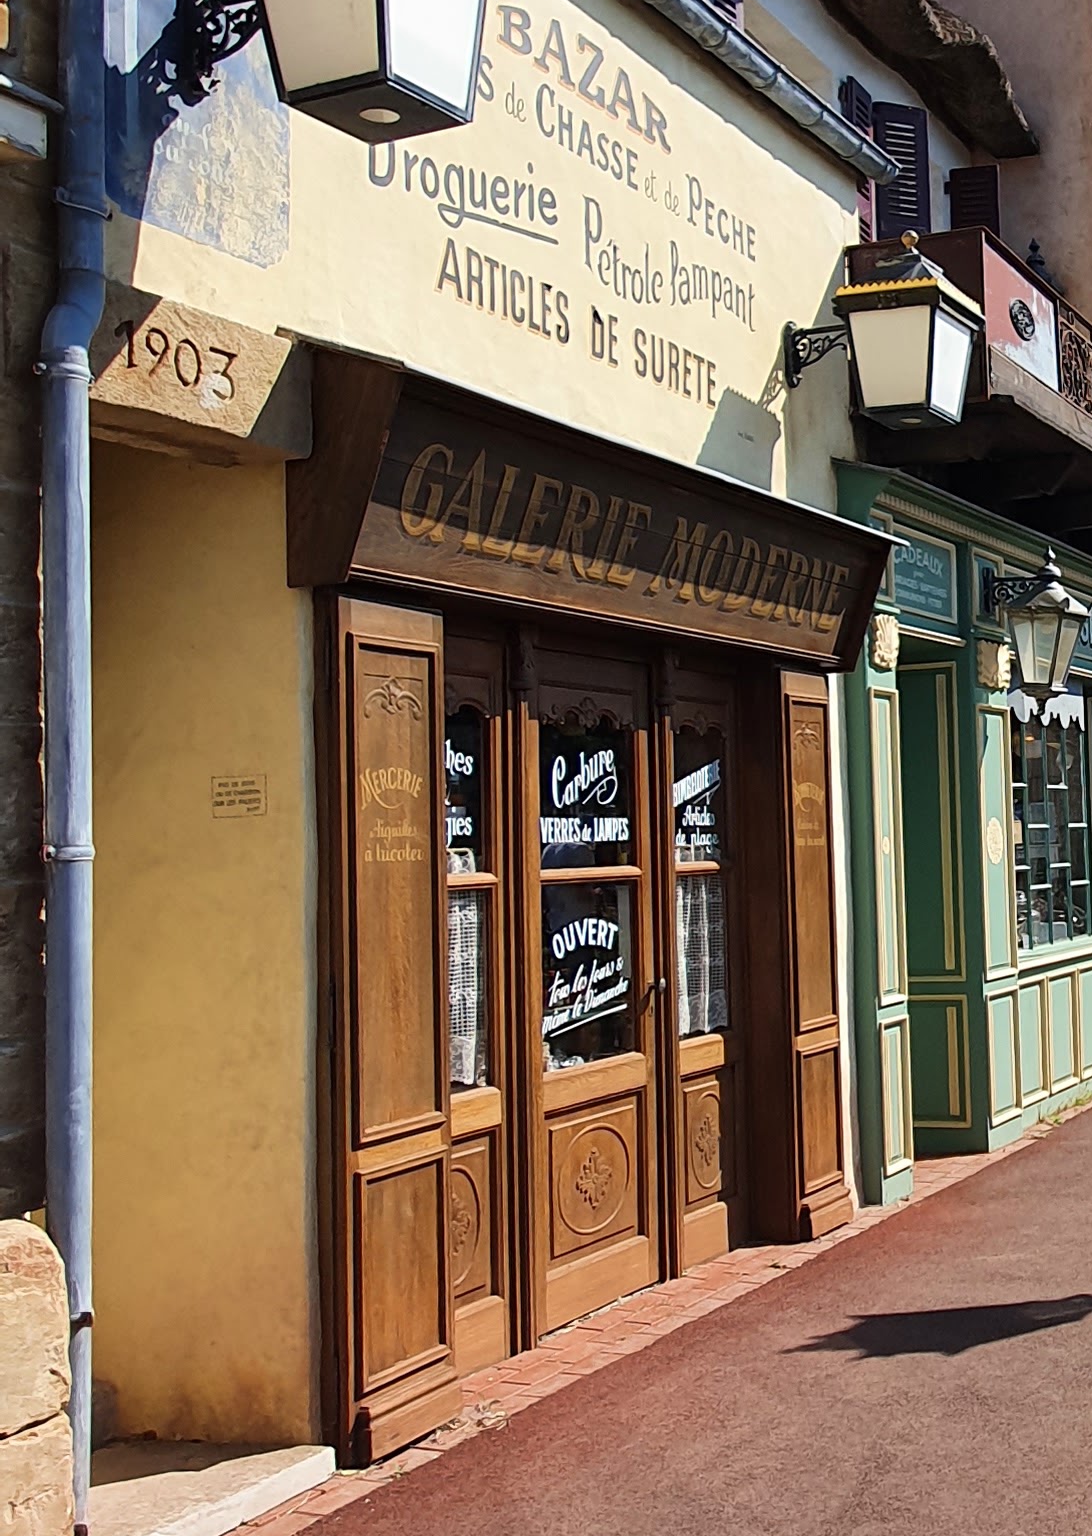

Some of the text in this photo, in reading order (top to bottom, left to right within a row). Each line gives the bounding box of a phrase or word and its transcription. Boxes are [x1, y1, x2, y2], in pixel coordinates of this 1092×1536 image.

[497, 5, 672, 155] BAZAR
[368, 140, 559, 245] Droguerie
[505, 81, 757, 263] de CHASSE et de PECHE
[582, 194, 664, 305] Pétrole
[114, 320, 238, 403] 1903
[434, 237, 717, 408] ARTICLES DE SURETE
[400, 442, 850, 633] GALERIE MODERNE
[893, 545, 943, 578] CADEAUX
[360, 766, 424, 810] MERCERIE
[445, 738, 474, 776] hes
[551, 748, 619, 810] Carbure
[539, 817, 630, 844] VERRES de LAMPES
[551, 917, 619, 960] OUVERT
